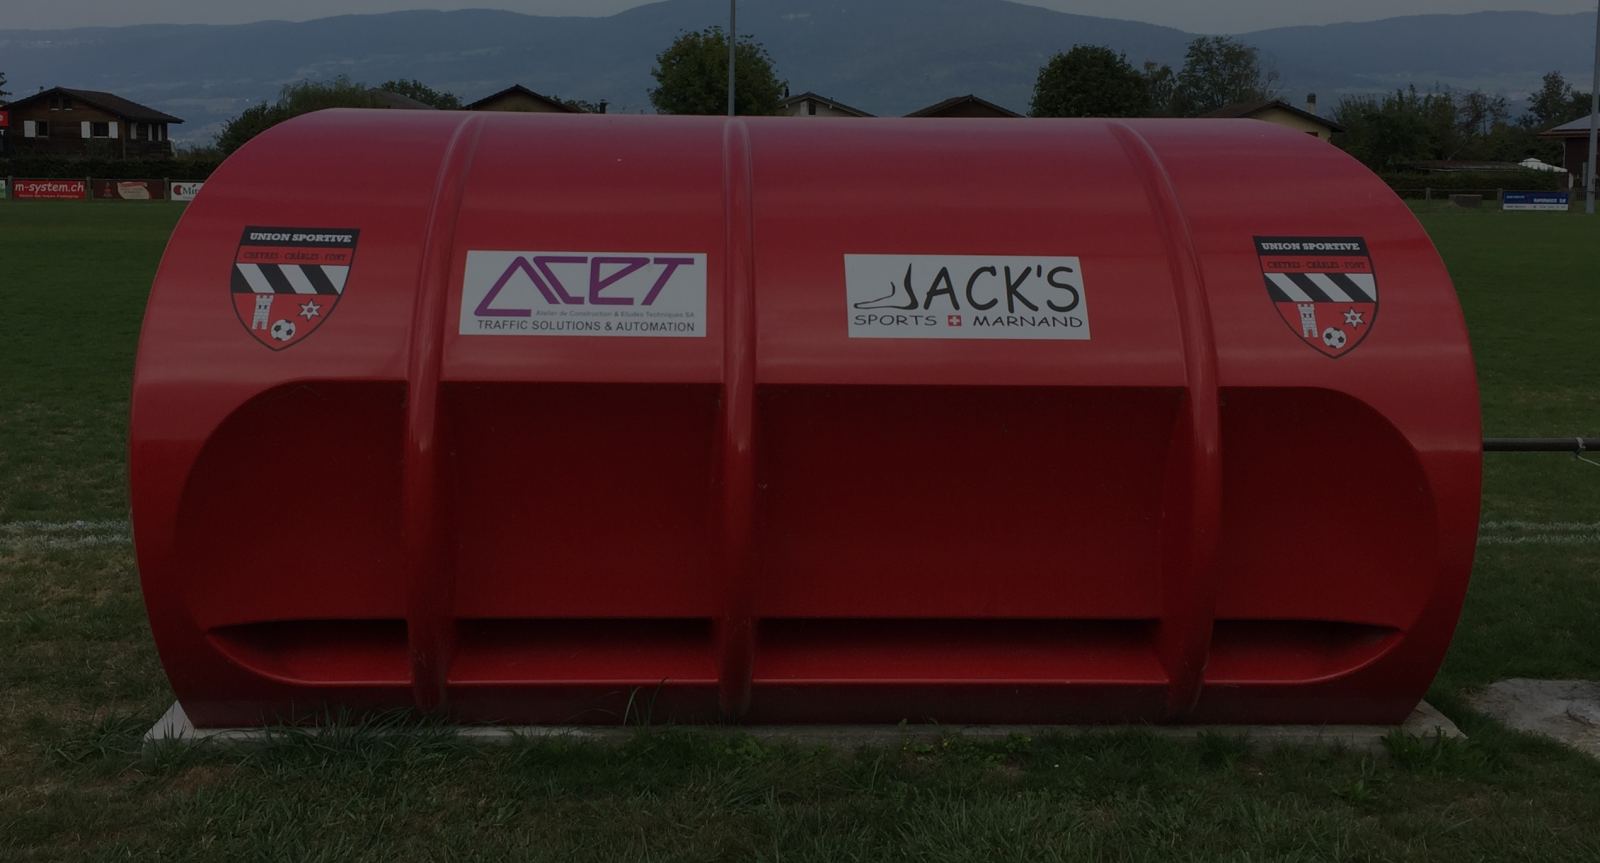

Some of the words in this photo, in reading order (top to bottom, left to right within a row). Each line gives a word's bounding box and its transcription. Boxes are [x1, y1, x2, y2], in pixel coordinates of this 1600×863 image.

[15, 181, 84, 194] m-system.ch
[250, 232, 289, 241] UNION
[291, 233, 353, 243] SPORTIVE
[1261, 242, 1301, 251] UNION
[1302, 242, 1361, 251] SPORTIVE
[854, 262, 1080, 314] JACK'S
[569, 310, 612, 318] Construction
[646, 311, 684, 320] Techniques
[853, 314, 937, 326] SPORTS
[973, 315, 1083, 328] MARNAND
[477, 319, 528, 331] TRAFFIC
[531, 320, 601, 332] SOLUTIONS
[604, 322, 613, 332] &
[616, 322, 695, 333] AUTOMATION
